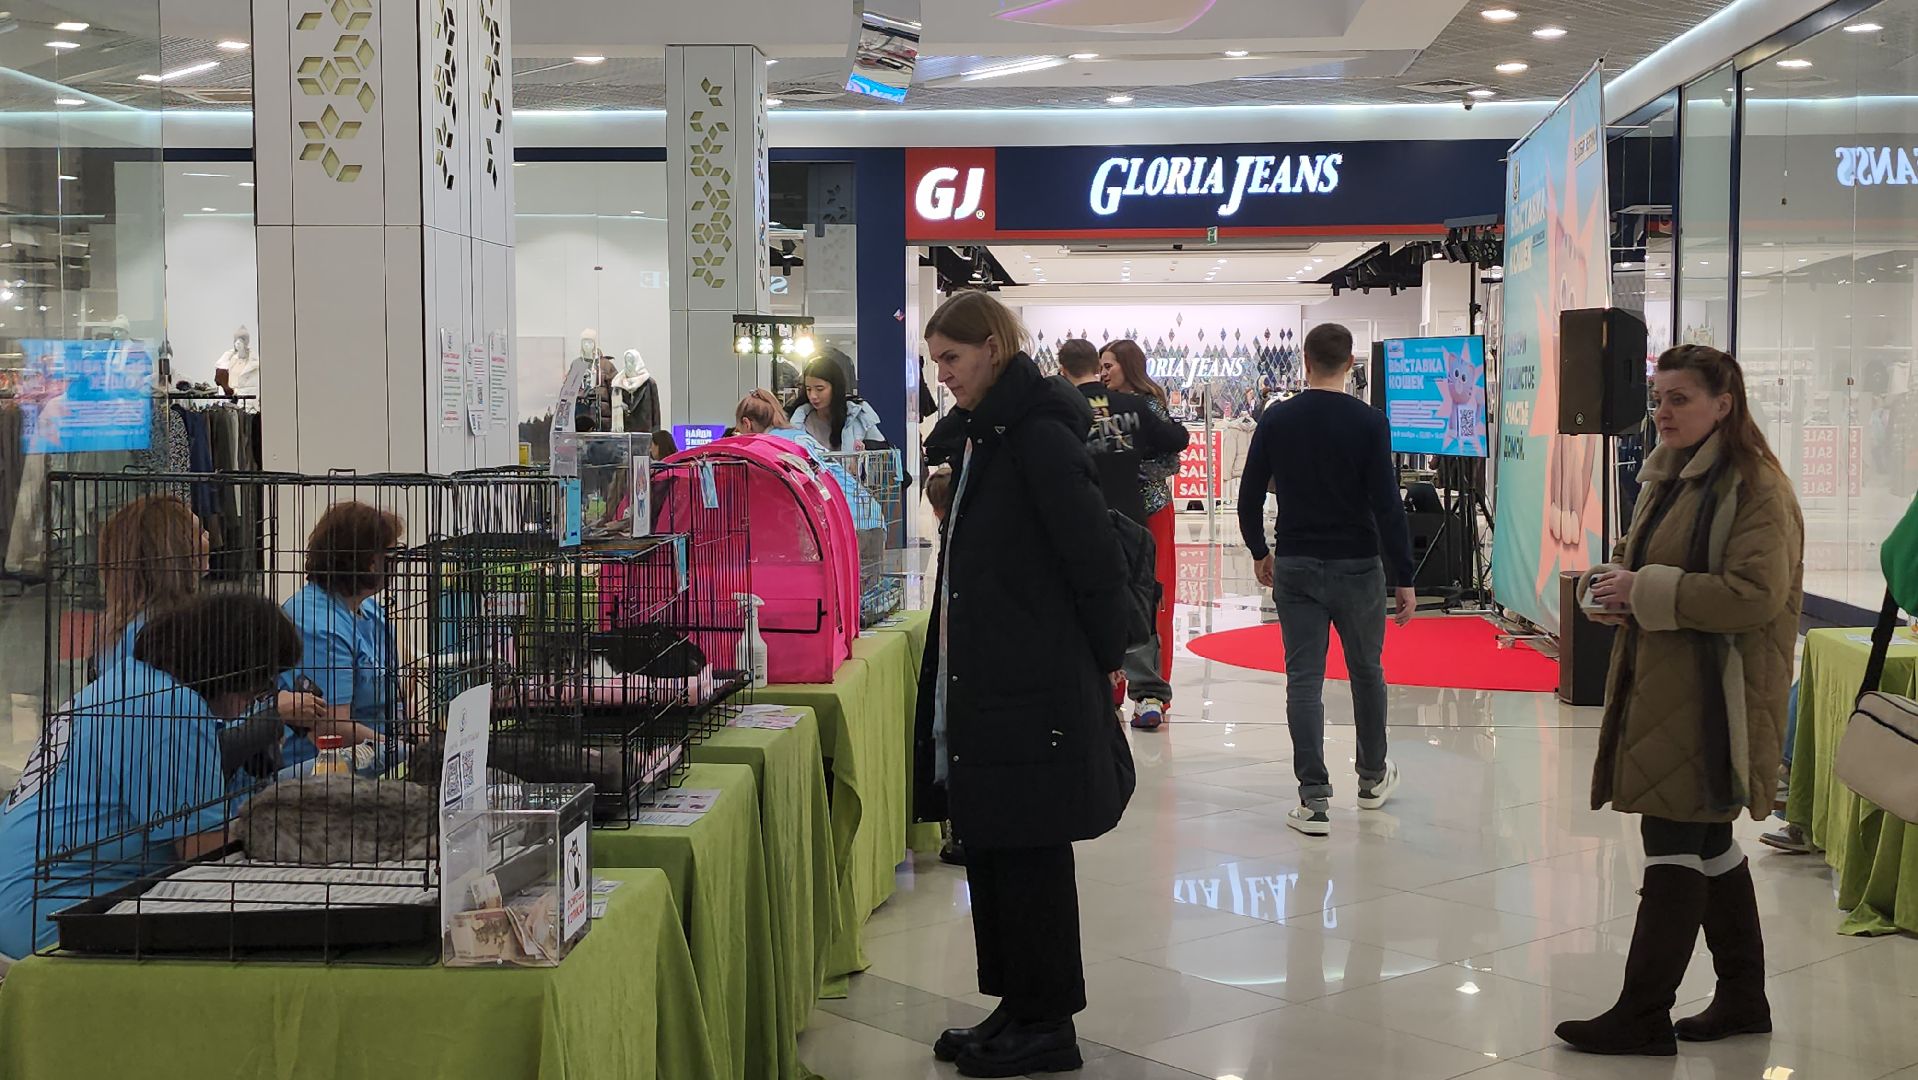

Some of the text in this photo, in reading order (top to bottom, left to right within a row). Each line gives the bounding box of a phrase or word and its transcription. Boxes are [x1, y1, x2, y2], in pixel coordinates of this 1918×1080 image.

[1090, 153, 1343, 216] GLORIA JEANS
[1147, 356, 1245, 388] ORIA JEANS
[1388, 358, 1444, 373] ВЫСТАВКА
[1388, 375, 1424, 389] КОШЕК
[1188, 432, 1217, 445] AL
